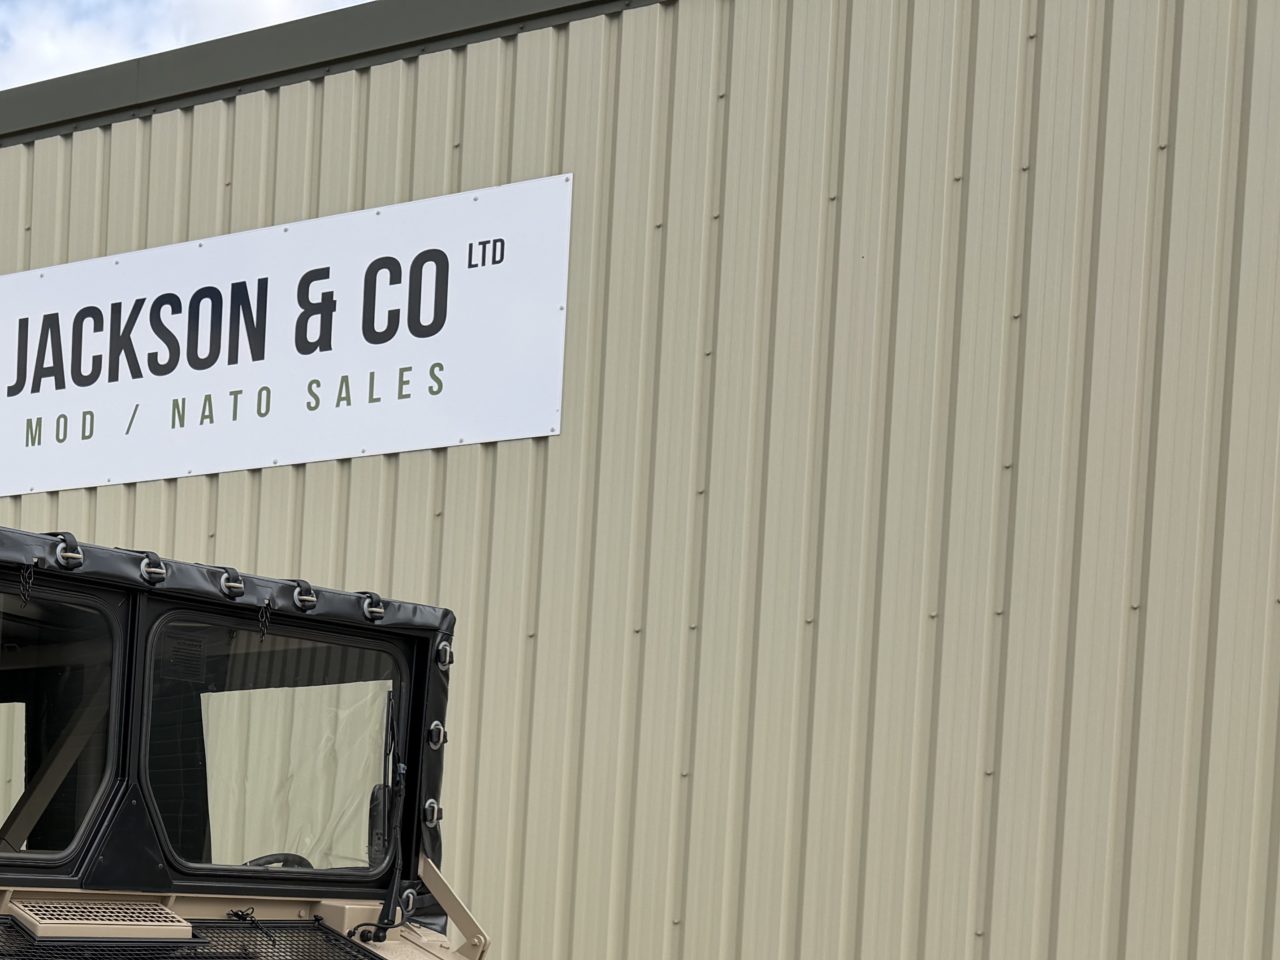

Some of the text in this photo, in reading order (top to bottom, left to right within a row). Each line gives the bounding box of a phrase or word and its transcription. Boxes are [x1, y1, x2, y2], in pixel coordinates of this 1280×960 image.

[7, 277, 269, 398] JACKSON
[295, 267, 336, 355] &
[362, 249, 449, 344] CO
[468, 239, 505, 268] LTD
[26, 411, 94, 447] MOD
[172, 386, 271, 429] NATO
[307, 363, 444, 411] SALES
